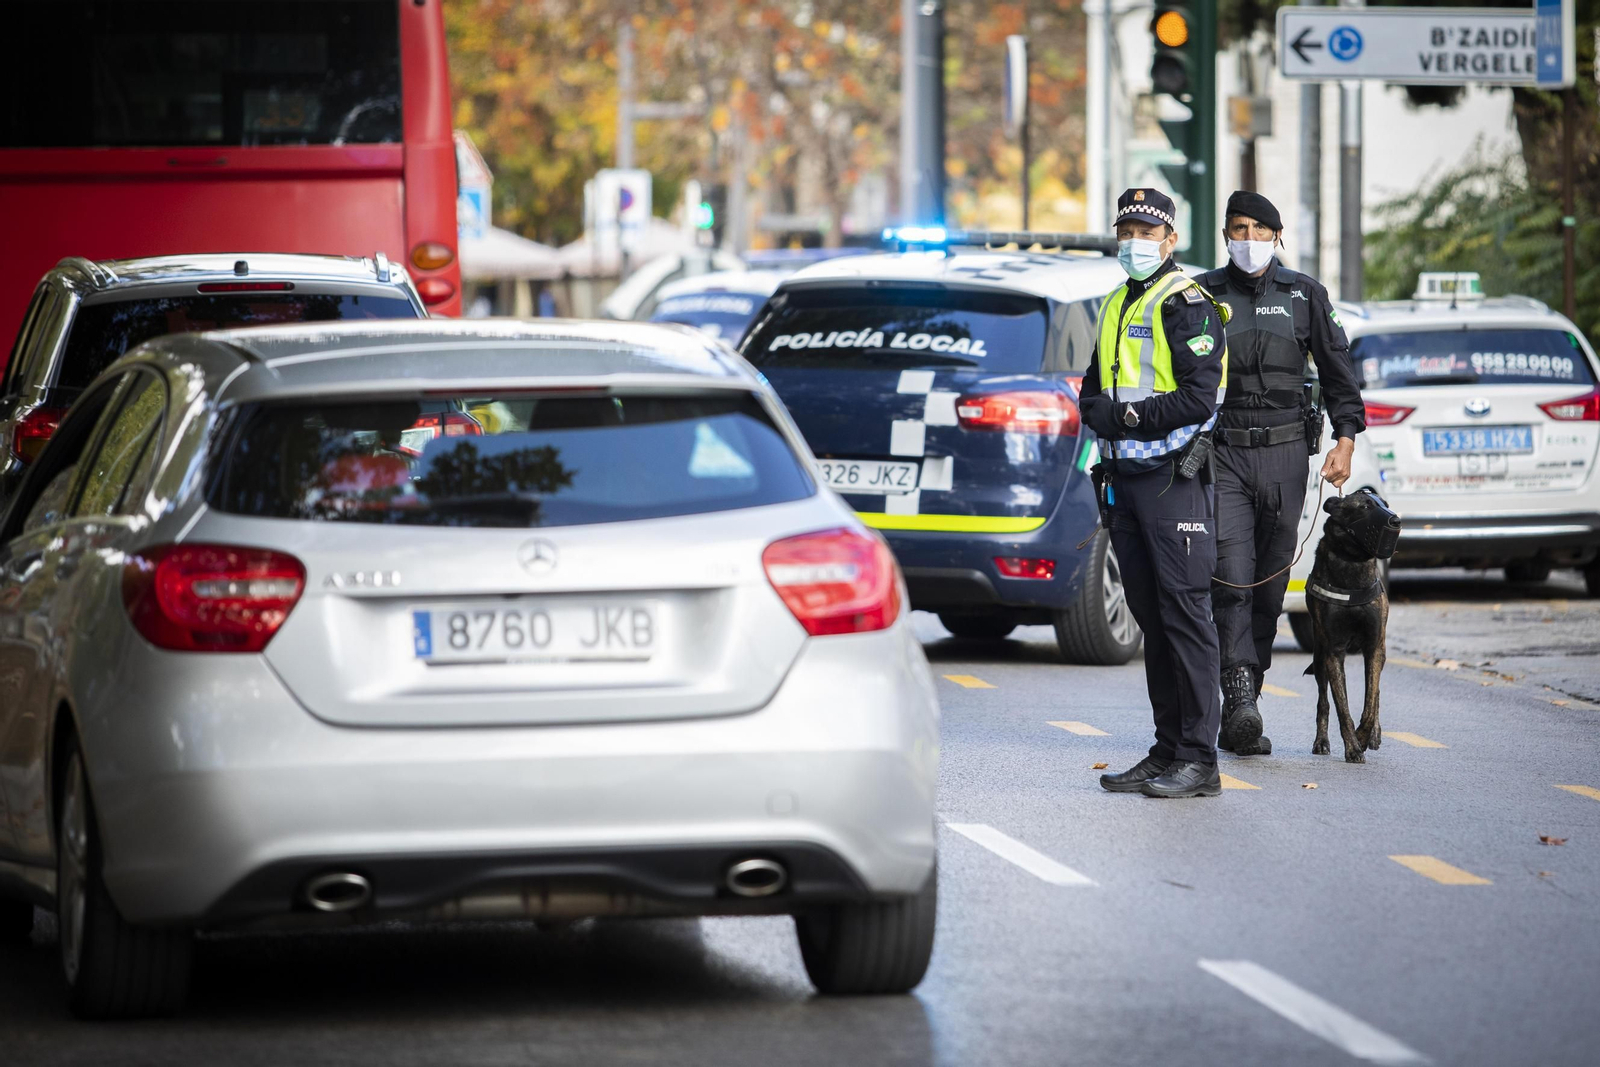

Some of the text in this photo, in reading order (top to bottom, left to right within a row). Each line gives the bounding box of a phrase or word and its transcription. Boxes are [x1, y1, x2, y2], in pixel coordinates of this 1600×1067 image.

[1419, 52, 1537, 73] VERGELE
[1256, 305, 1288, 317] POLICIA
[769, 327, 987, 357] POLICÍA LOCAL
[1491, 427, 1528, 450] HZY
[815, 463, 910, 486] 326 JKZ
[1177, 522, 1207, 533] POLICIA
[448, 606, 654, 650] 8760 JKB
